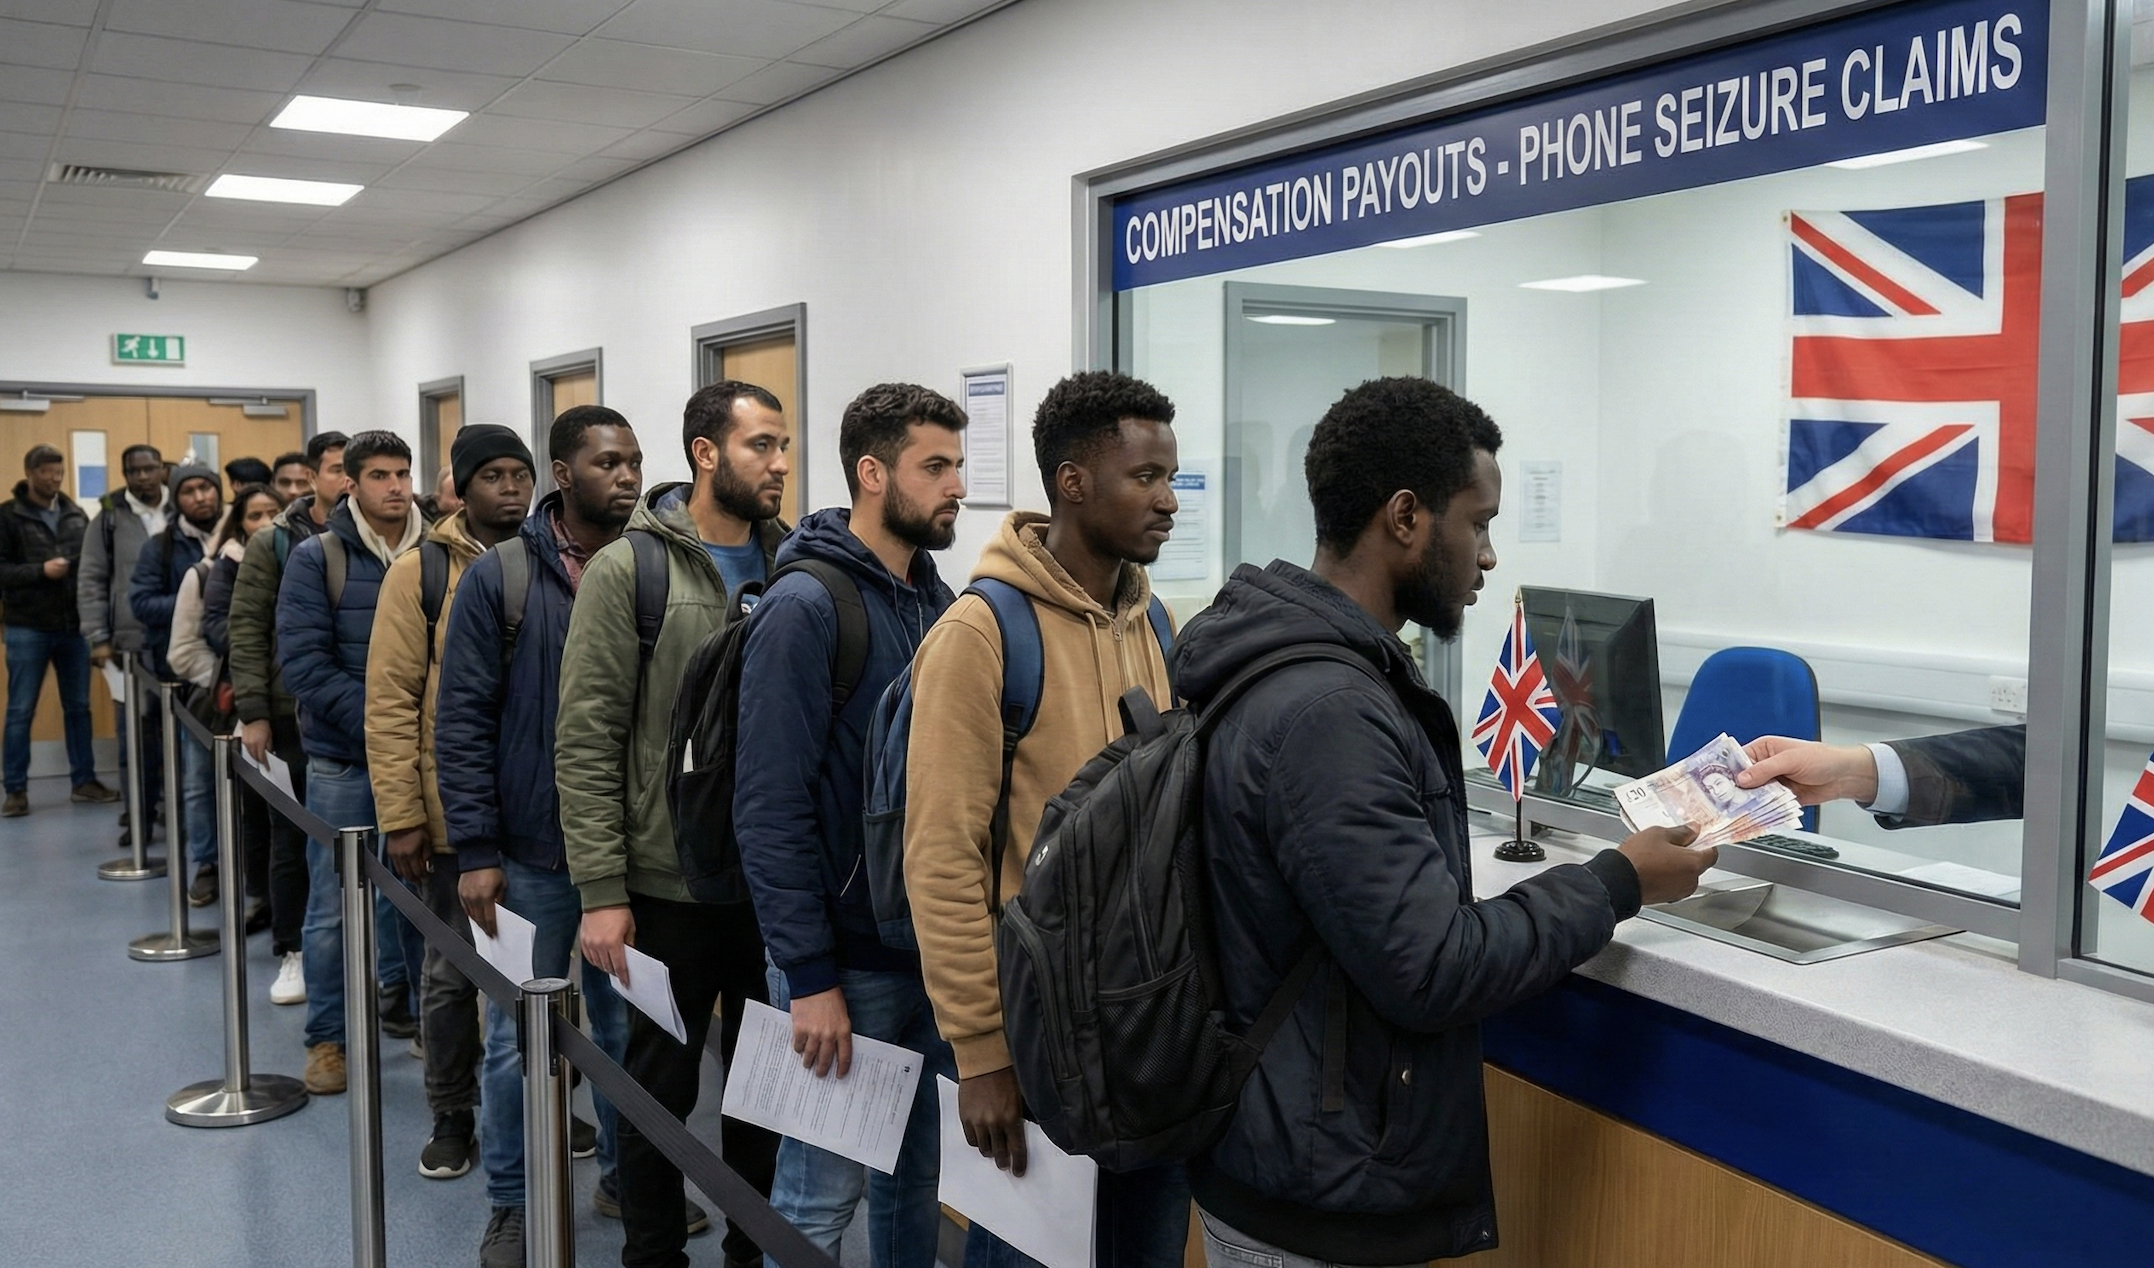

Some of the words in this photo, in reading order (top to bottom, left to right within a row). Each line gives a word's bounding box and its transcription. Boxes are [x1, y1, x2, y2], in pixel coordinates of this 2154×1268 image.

[1126, 171, 1332, 265] COMPENSATION
[1342, 136, 1487, 221] PAYOUTS
[1497, 160, 1509, 175] -
[1519, 100, 1642, 186] PHONE
[1654, 58, 1827, 158] SEIZURE
[1841, 14, 2022, 120] CLAIMS
